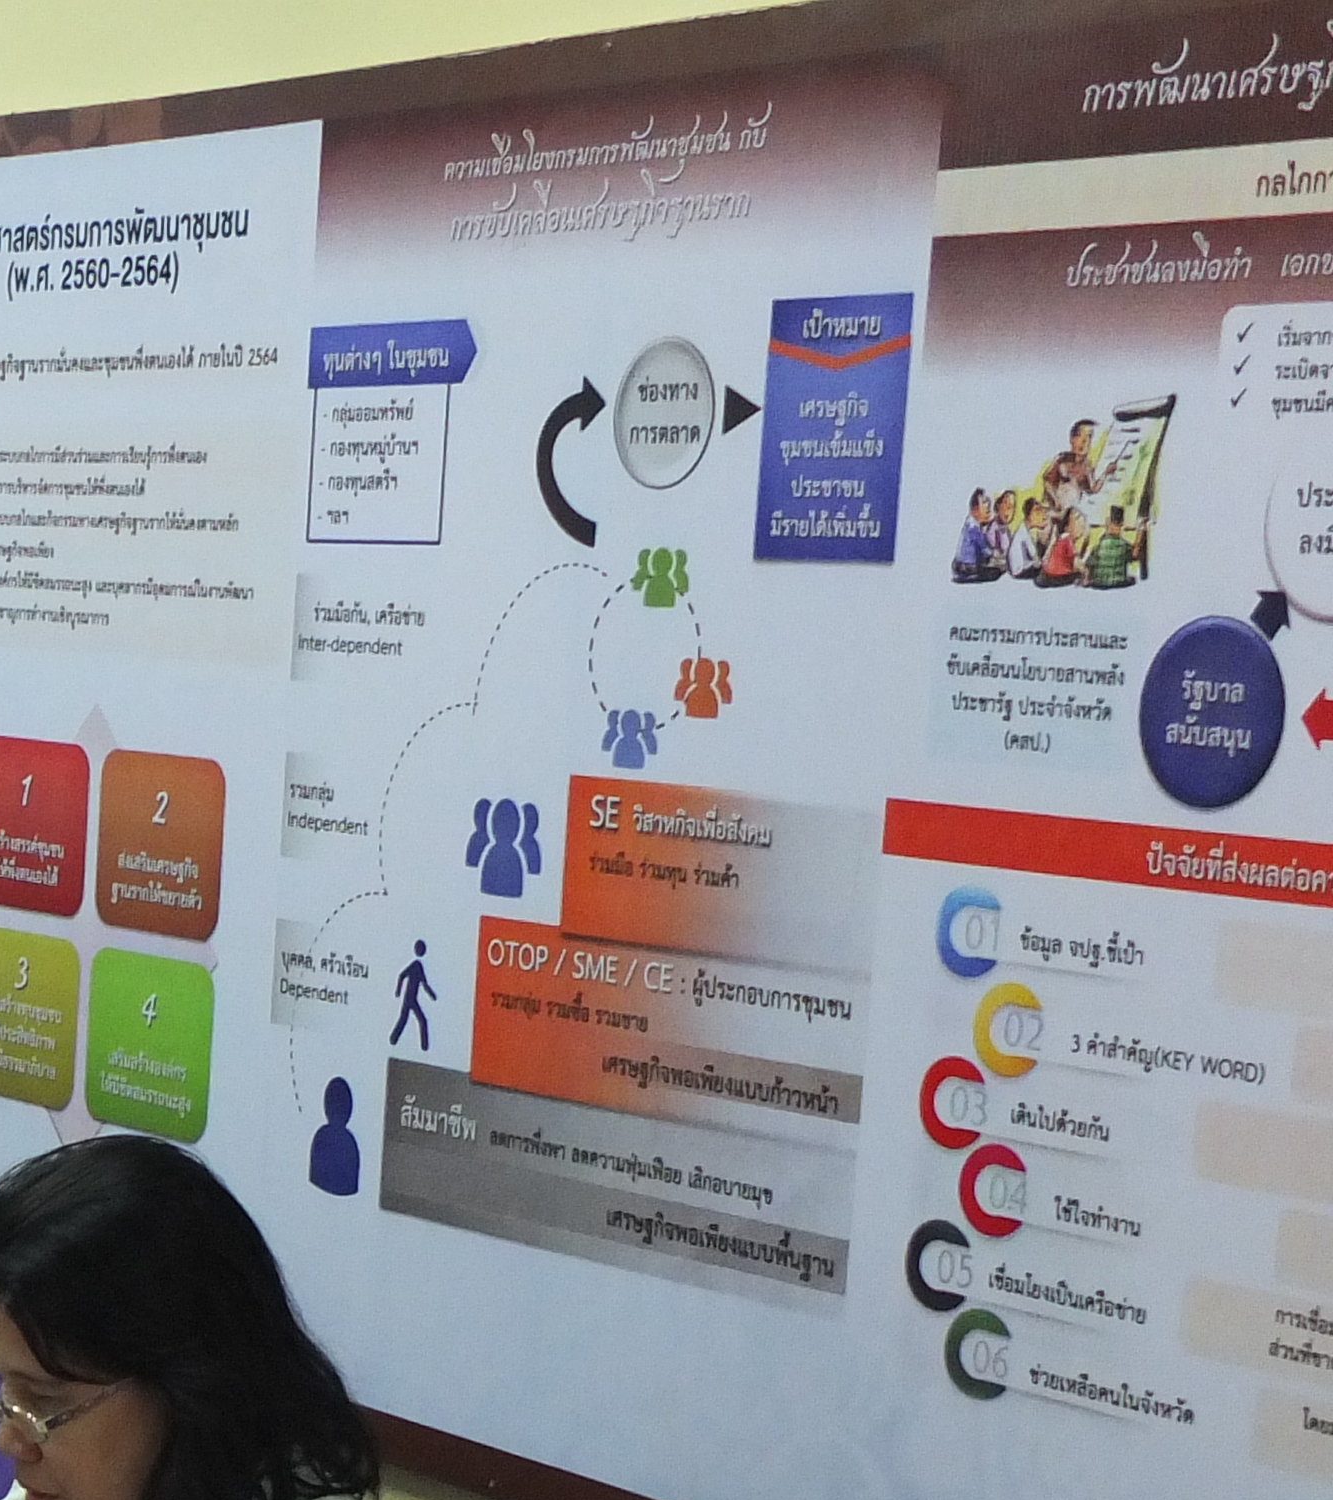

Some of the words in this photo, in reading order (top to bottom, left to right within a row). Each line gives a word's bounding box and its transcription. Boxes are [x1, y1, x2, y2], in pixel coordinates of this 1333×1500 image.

[1082, 19, 1333, 112] การพัฒนาเศรษฐ
[444, 111, 731, 183] ความเชื่อมโยงกรมการพัฒนาชุมชน
[739, 101, 773, 150] กับ
[7, 261, 54, 302] (พ.ศ.
[61, 251, 179, 294] 2560-2564)
[802, 308, 882, 340] เป้าหมาย
[197, 344, 244, 369] ภายในปี
[248, 347, 279, 366] 2564
[323, 345, 382, 380] ทุนต่างๆ
[387, 341, 450, 377] ในชุมชน
[638, 376, 699, 402] ช่องทาง
[331, 398, 415, 429] กลุ่มออมทรัพย์
[799, 391, 869, 426] เศรษฐกิจ
[629, 425, 701, 444] การตลาด
[779, 429, 884, 466] ชุมชนเข้มแข็ง
[790, 474, 866, 498] ประชาชน
[327, 510, 349, 525] ฯลฯ
[770, 503, 881, 539] มีรายได้เพิ่มขึ้น
[949, 624, 1128, 650] คณะกรรมการประสานและ
[952, 691, 1013, 722] ประชารัฐ
[1018, 694, 1112, 722] ประจำจังหวัด
[1182, 670, 1245, 711] รัฐบาล
[1165, 715, 1253, 758] สนับสนุน
[21, 774, 34, 808] 1
[151, 791, 170, 826] 2
[287, 810, 369, 836] Independent
[589, 794, 621, 830] SE
[632, 803, 772, 847] วิสาหกิจเพื่อสังคม
[1020, 925, 1062, 961] ข้อมูล
[14, 957, 30, 990] 3
[279, 978, 349, 1005] Dependent
[487, 938, 549, 972] OTOP
[572, 951, 619, 983] SME
[643, 961, 675, 992] CE
[692, 968, 853, 1023] ผู้ประกอบการชุมชน
[141, 993, 158, 1028] 4
[1070, 1034, 1081, 1053] 3
[1201, 1054, 1267, 1086] WORD)
[601, 1055, 839, 1115] เศรษฐกิจพอเพียงแบบก้าวหน้า
[400, 1094, 477, 1141] สัมมาชีพ
[1053, 1195, 1142, 1237] ใช้ใจทำงาน
[938, 1250, 973, 1288] 05
[988, 1263, 1147, 1325] เชื่อมโยงเป็นเครือข่าย
[1030, 1364, 1195, 1425] ช่วยเหลือคนในจังหวัด
